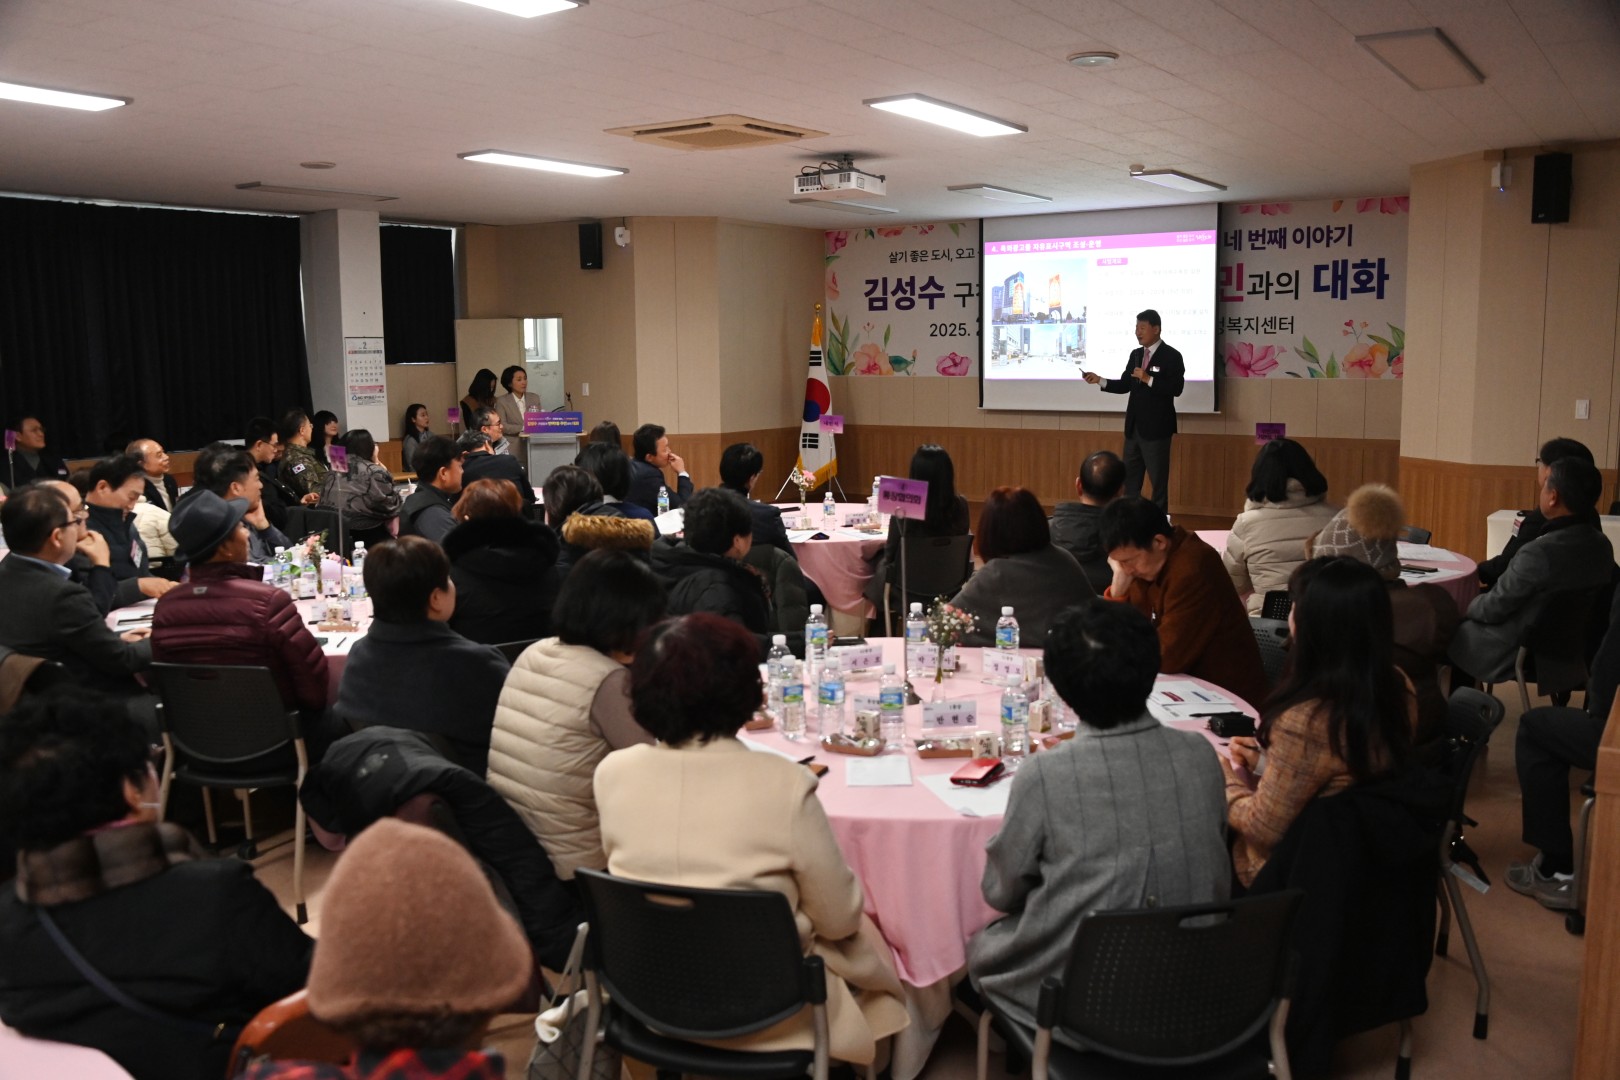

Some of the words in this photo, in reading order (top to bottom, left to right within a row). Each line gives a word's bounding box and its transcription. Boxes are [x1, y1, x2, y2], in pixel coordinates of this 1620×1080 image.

[1223, 229, 1243, 252] 네
[1247, 226, 1287, 251] 번째
[1292, 224, 1353, 249] 이야기
[888, 250, 908, 264] 살기
[909, 249, 929, 263] 좋은
[931, 247, 953, 263] 도시,
[955, 247, 976, 260] 오고
[1312, 257, 1390, 301] 대화
[863, 275, 946, 312] 김성수
[929, 322, 971, 337] 2025.
